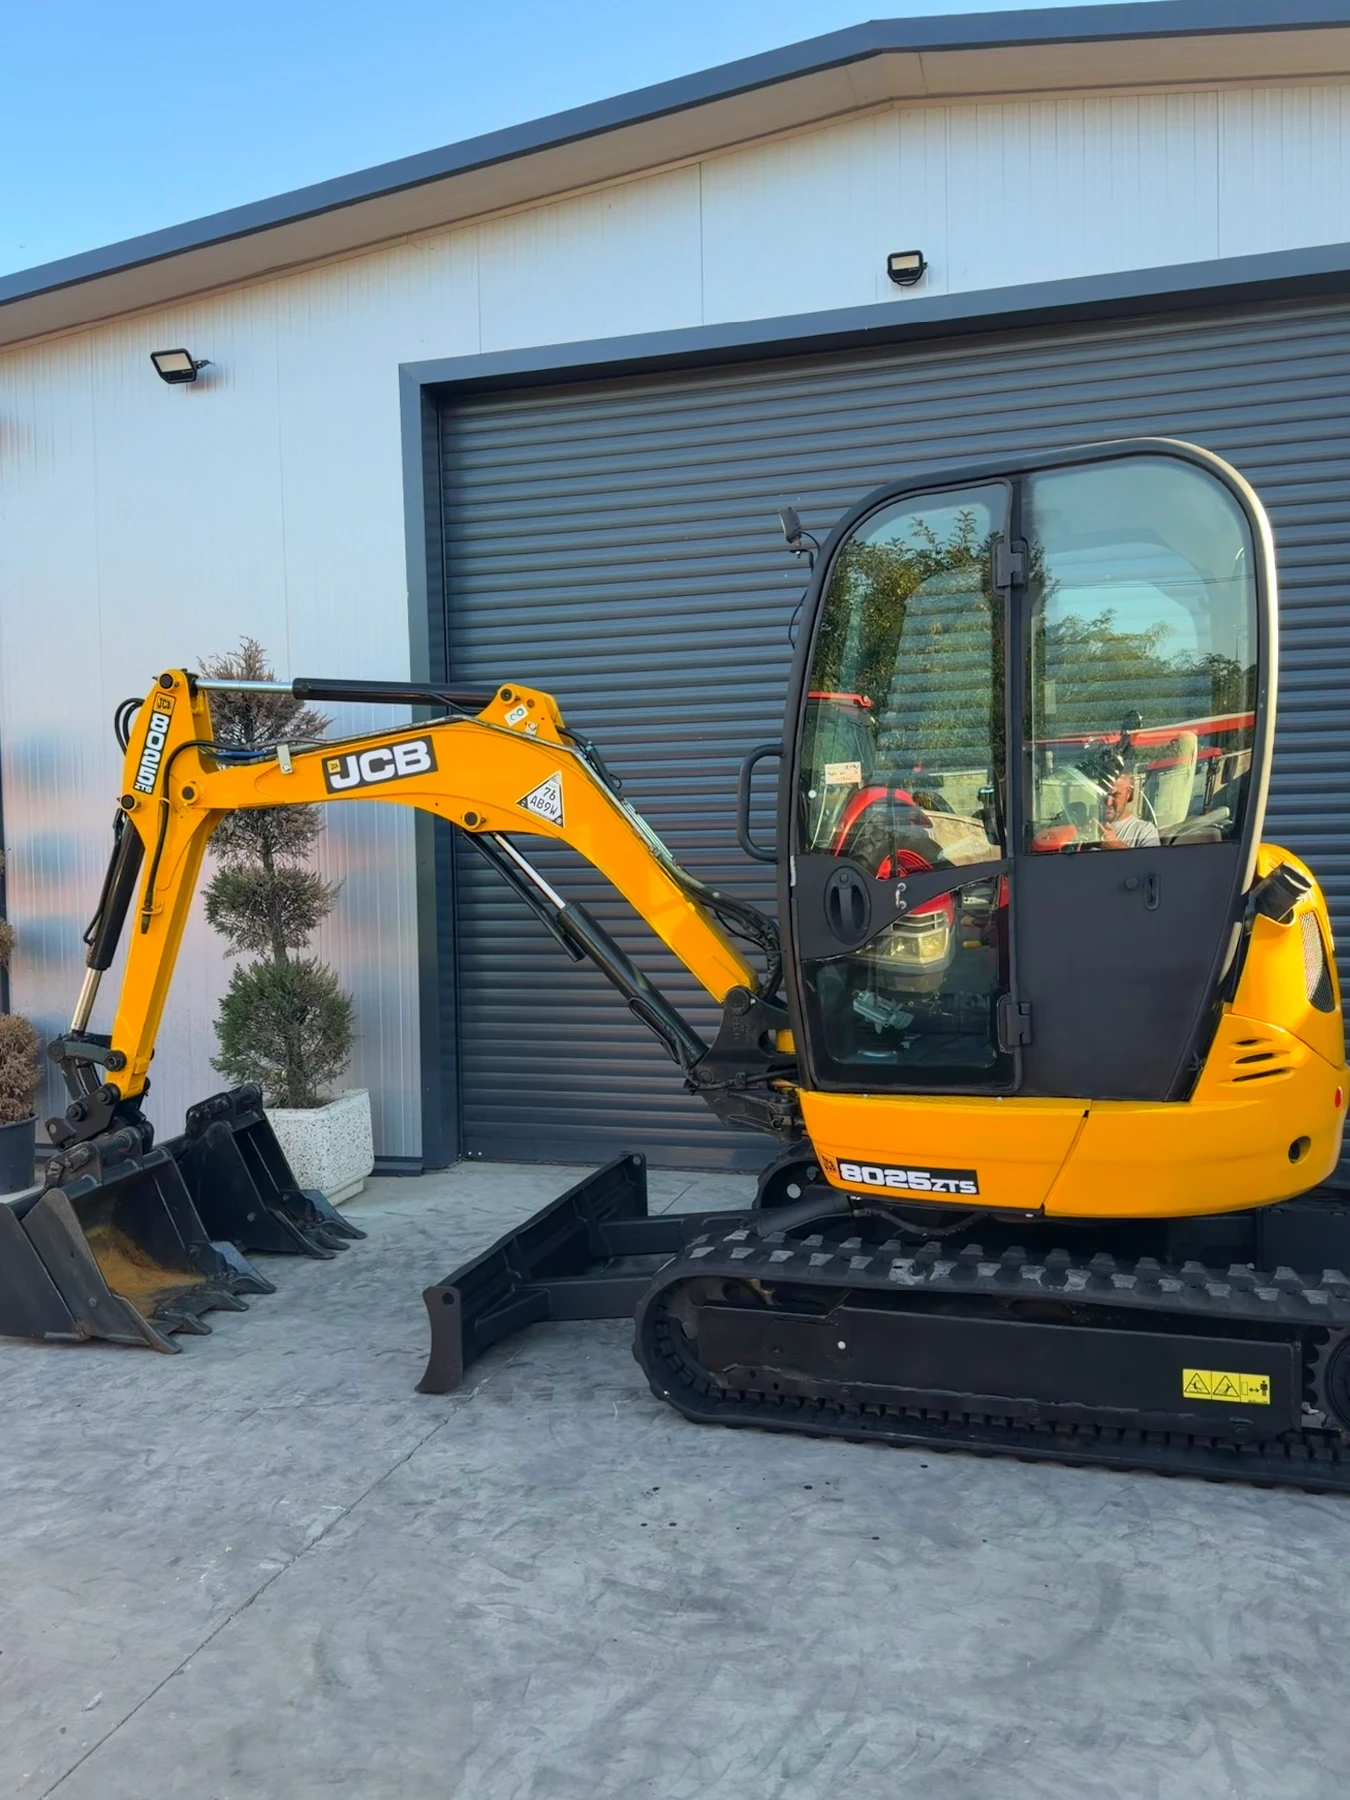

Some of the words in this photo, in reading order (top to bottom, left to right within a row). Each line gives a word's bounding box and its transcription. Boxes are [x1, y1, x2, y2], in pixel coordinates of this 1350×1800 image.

[156, 698, 171, 710] JCB
[136, 712, 170, 787] 8025
[329, 740, 431, 789] JCB
[529, 795, 558, 815] AB9W
